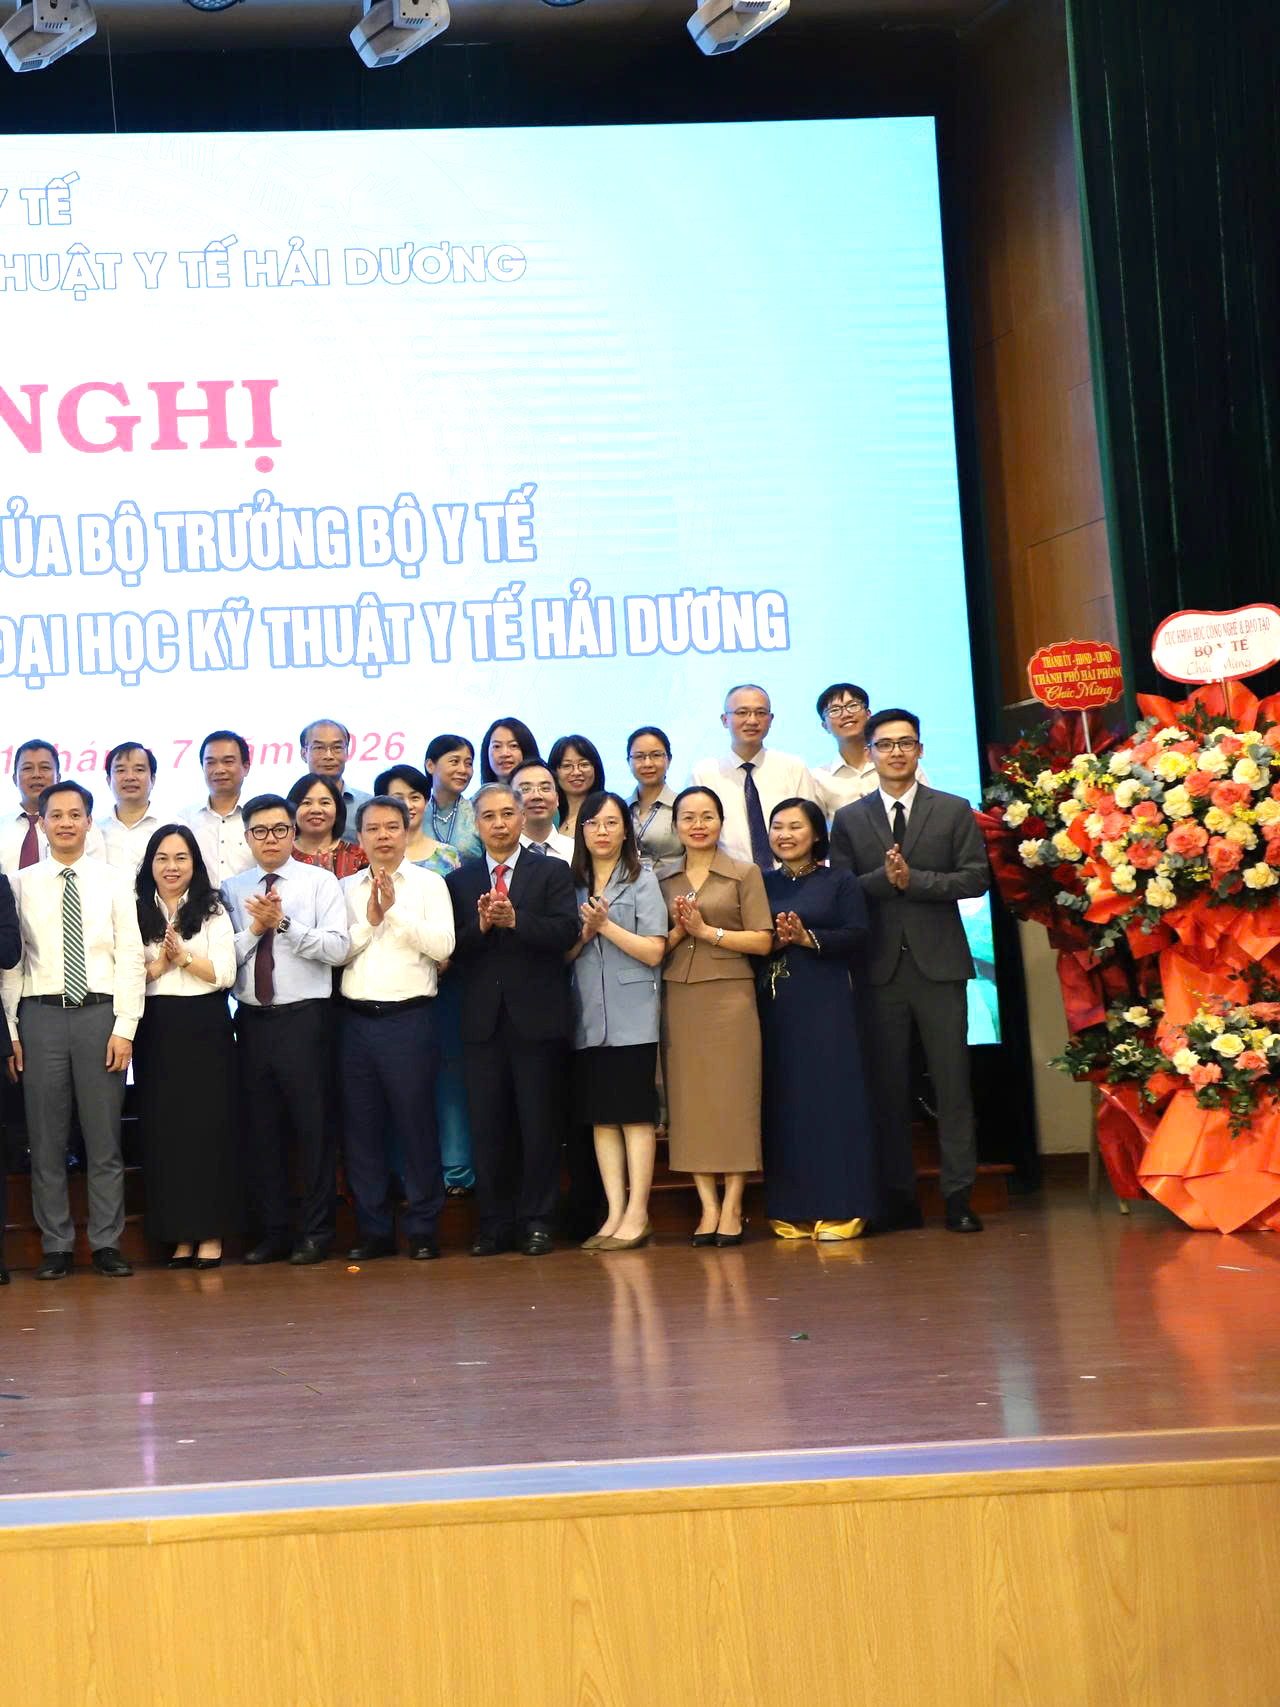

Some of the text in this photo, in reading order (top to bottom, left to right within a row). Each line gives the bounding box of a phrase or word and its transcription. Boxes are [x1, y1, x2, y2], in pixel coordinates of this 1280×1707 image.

[19, 171, 80, 225] TẾ
[133, 252, 167, 289] Y
[179, 234, 238, 288] TẾ
[244, 236, 330, 287] HẢI
[344, 241, 526, 285] DƯƠNG
[78, 500, 148, 587] BỘ
[154, 489, 351, 573] TRƯỞNG
[357, 492, 427, 579] BỘ
[432, 503, 469, 564] Y
[475, 482, 538, 563] TẾ
[77, 610, 179, 686] HỌC
[188, 596, 254, 671] KỸ
[260, 592, 414, 678] THUẬT
[420, 601, 456, 663] Y
[463, 581, 526, 662] TẾ
[532, 578, 617, 659] HẢI
[623, 586, 790, 656] DƯƠNG
[1194, 641, 1213, 658] BỘ
[1231, 636, 1249, 652] TẾ
[1033, 670, 1063, 685] THÀNH
[1063, 665, 1080, 683] PHỐ
[1080, 665, 1096, 681] HẢI
[172, 739, 193, 769] 7
